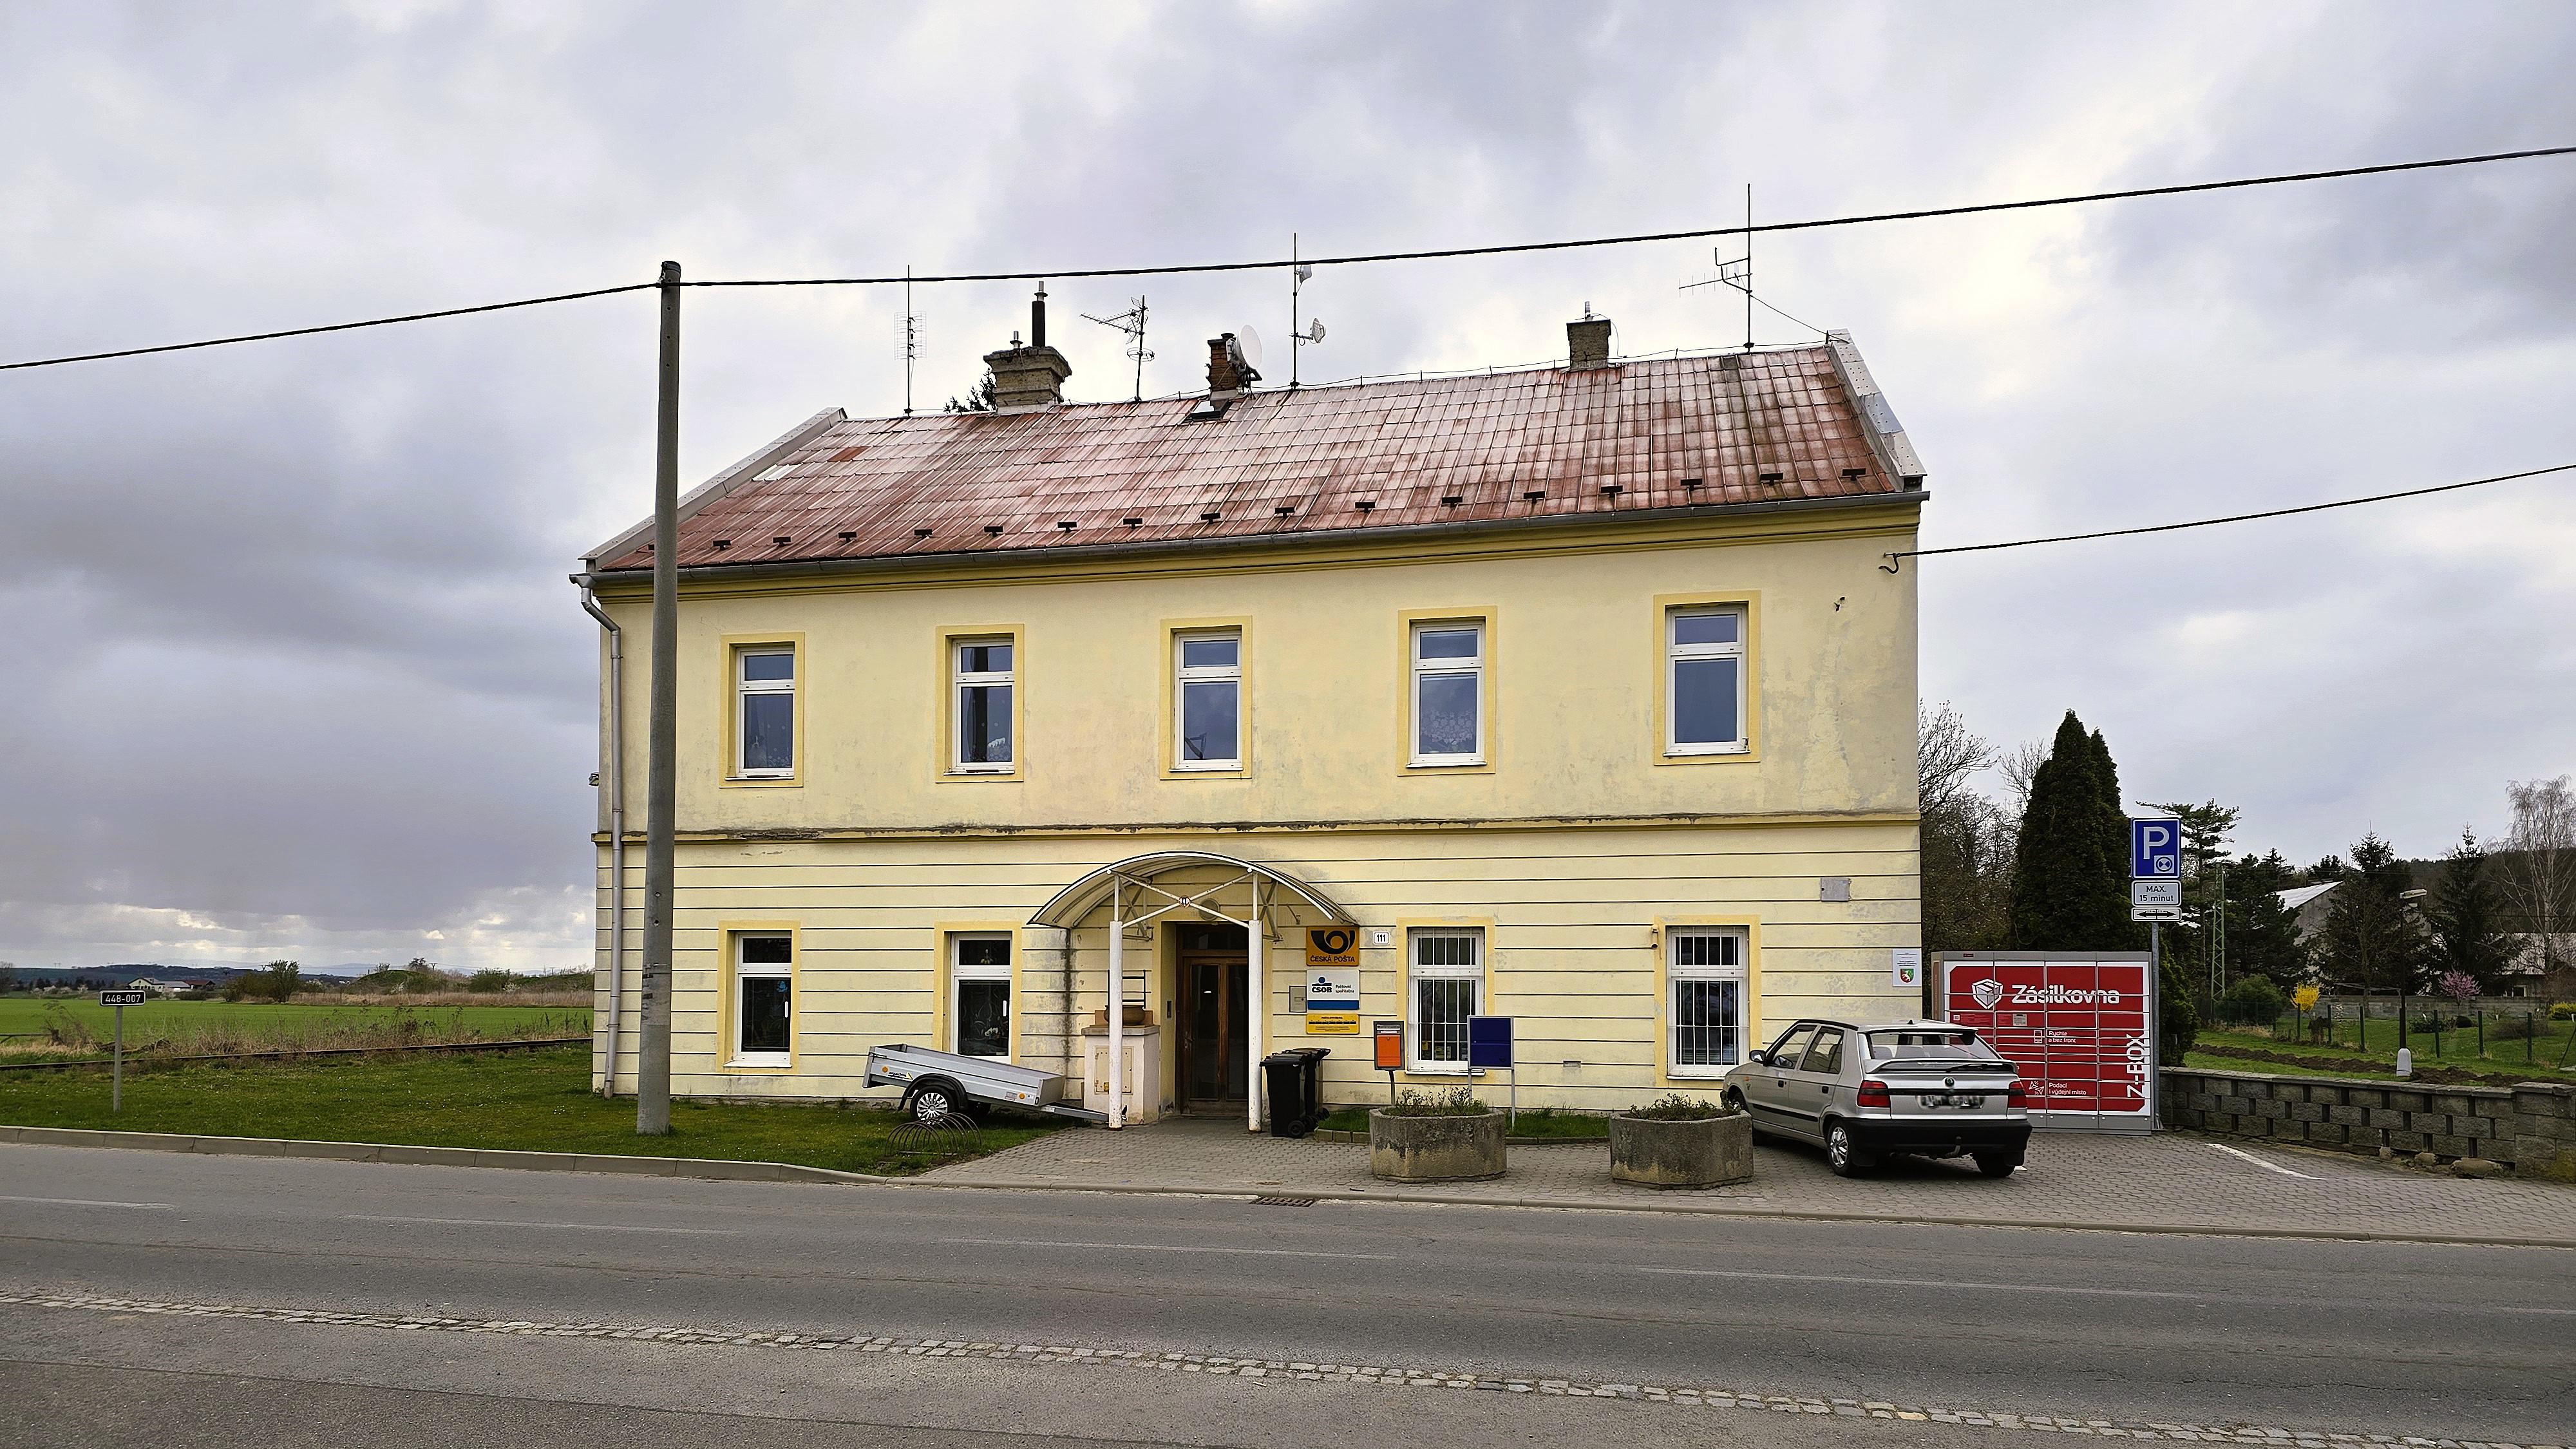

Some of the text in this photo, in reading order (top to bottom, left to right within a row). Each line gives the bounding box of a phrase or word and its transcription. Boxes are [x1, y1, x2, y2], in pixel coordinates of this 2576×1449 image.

[2143, 826, 2170, 860] P
[1377, 934, 1385, 942] 111
[105, 994, 141, 1003] 448-007
[2011, 985, 2120, 1004] Zásilkovna
[2126, 1034, 2145, 1097] Z-BOX
